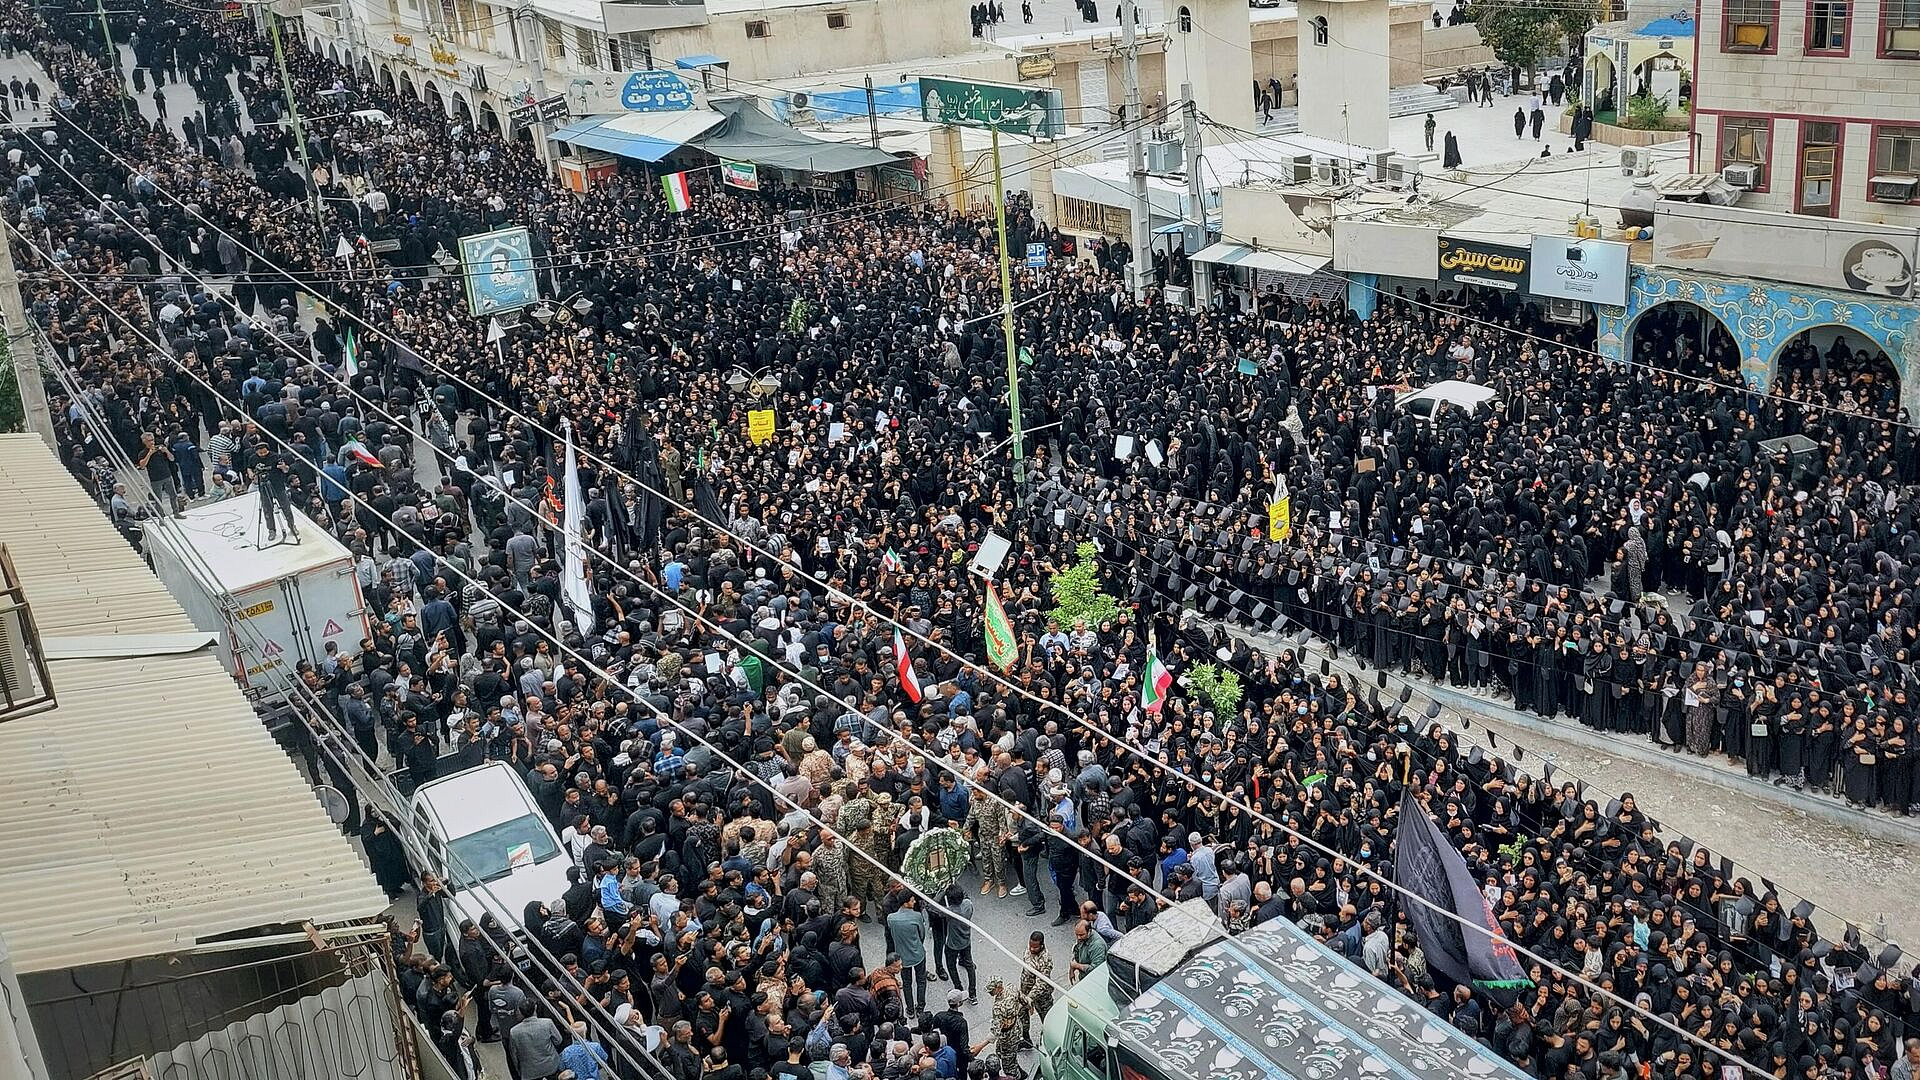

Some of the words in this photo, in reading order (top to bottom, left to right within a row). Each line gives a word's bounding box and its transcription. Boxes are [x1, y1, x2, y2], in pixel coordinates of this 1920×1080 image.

[627, 93, 652, 104] مت
[655, 93, 665, 106] و
[666, 90, 690, 106] پت
[1036, 245, 1044, 256] P
[1440, 247, 1487, 272] سیتی
[1487, 254, 1526, 274] ست
[418, 402, 429, 414] 10
